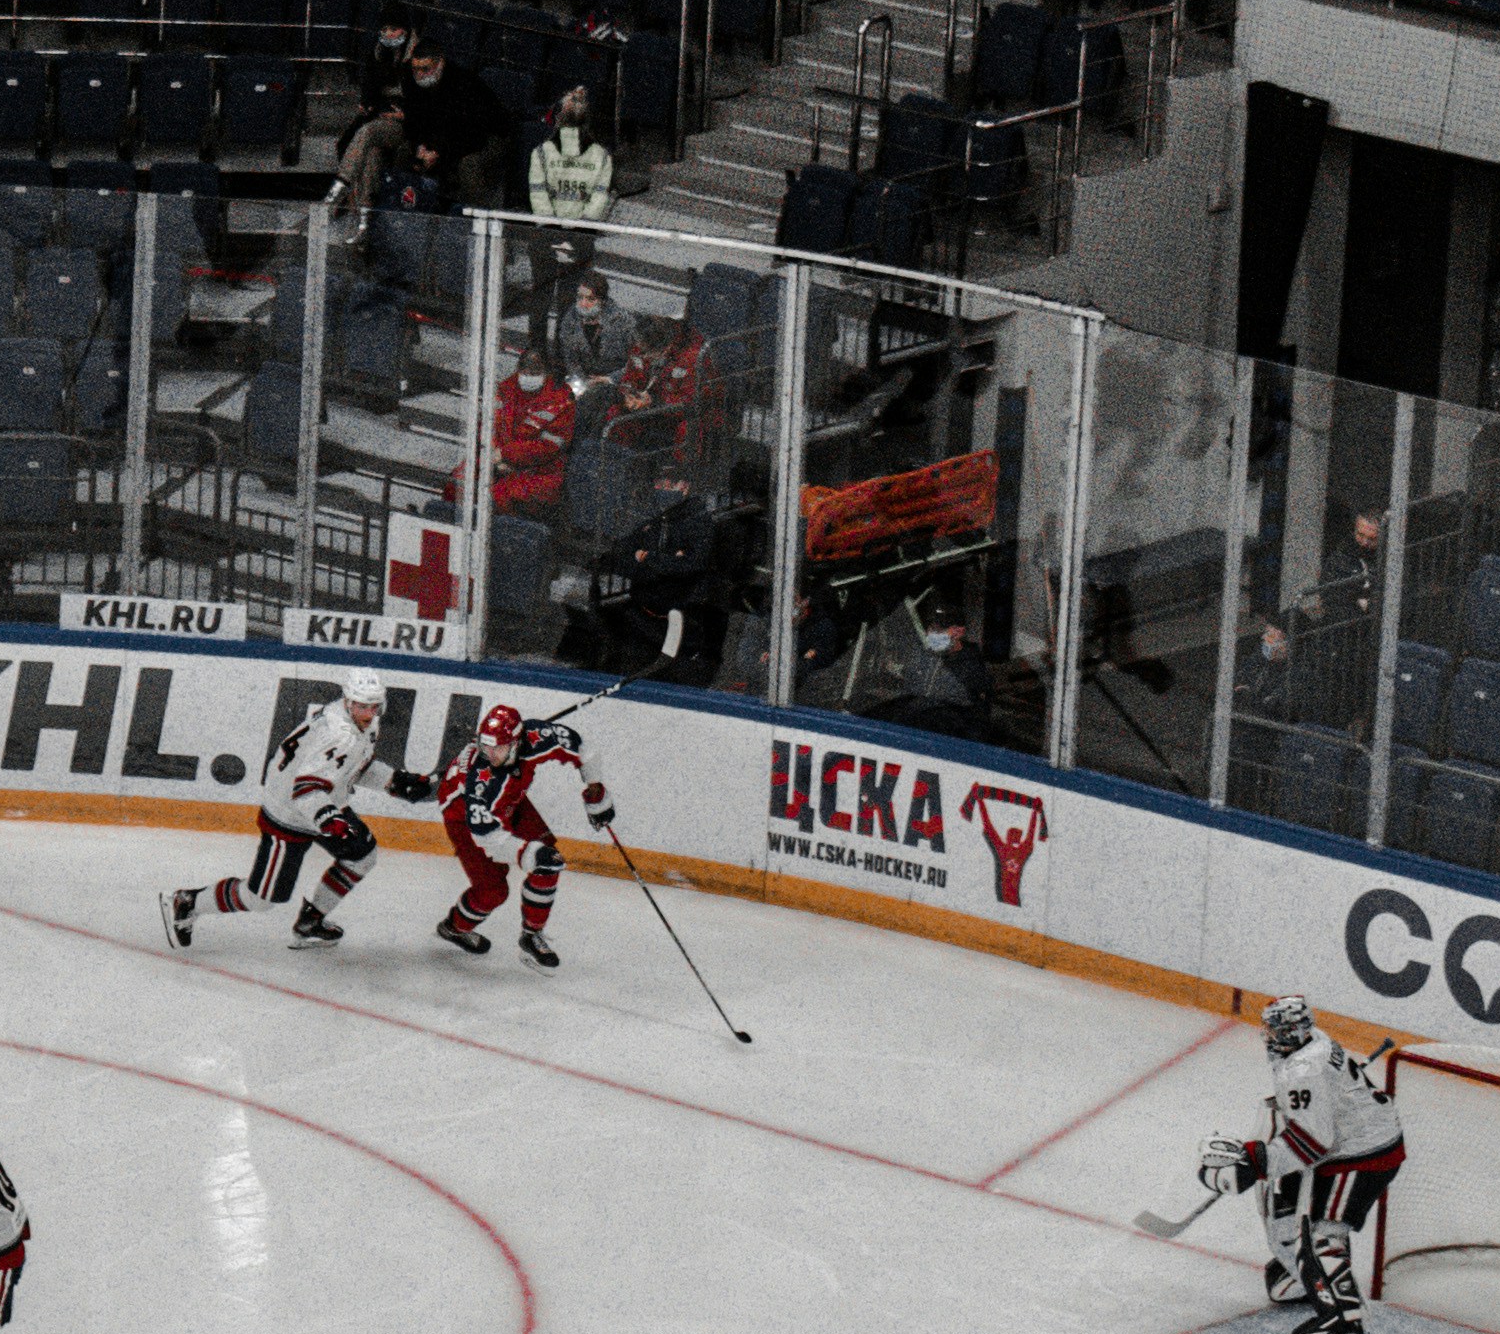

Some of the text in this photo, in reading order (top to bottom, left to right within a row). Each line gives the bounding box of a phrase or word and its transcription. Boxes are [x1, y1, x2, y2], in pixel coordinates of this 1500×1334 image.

[83, 599, 223, 635] KHL.RU
[305, 614, 445, 653] KHL.RU
[768, 739, 946, 854] ЦСКА
[767, 830, 948, 889] WWW.CSKA-HOCKEY.RU
[1287, 1088, 1313, 1111] 39
